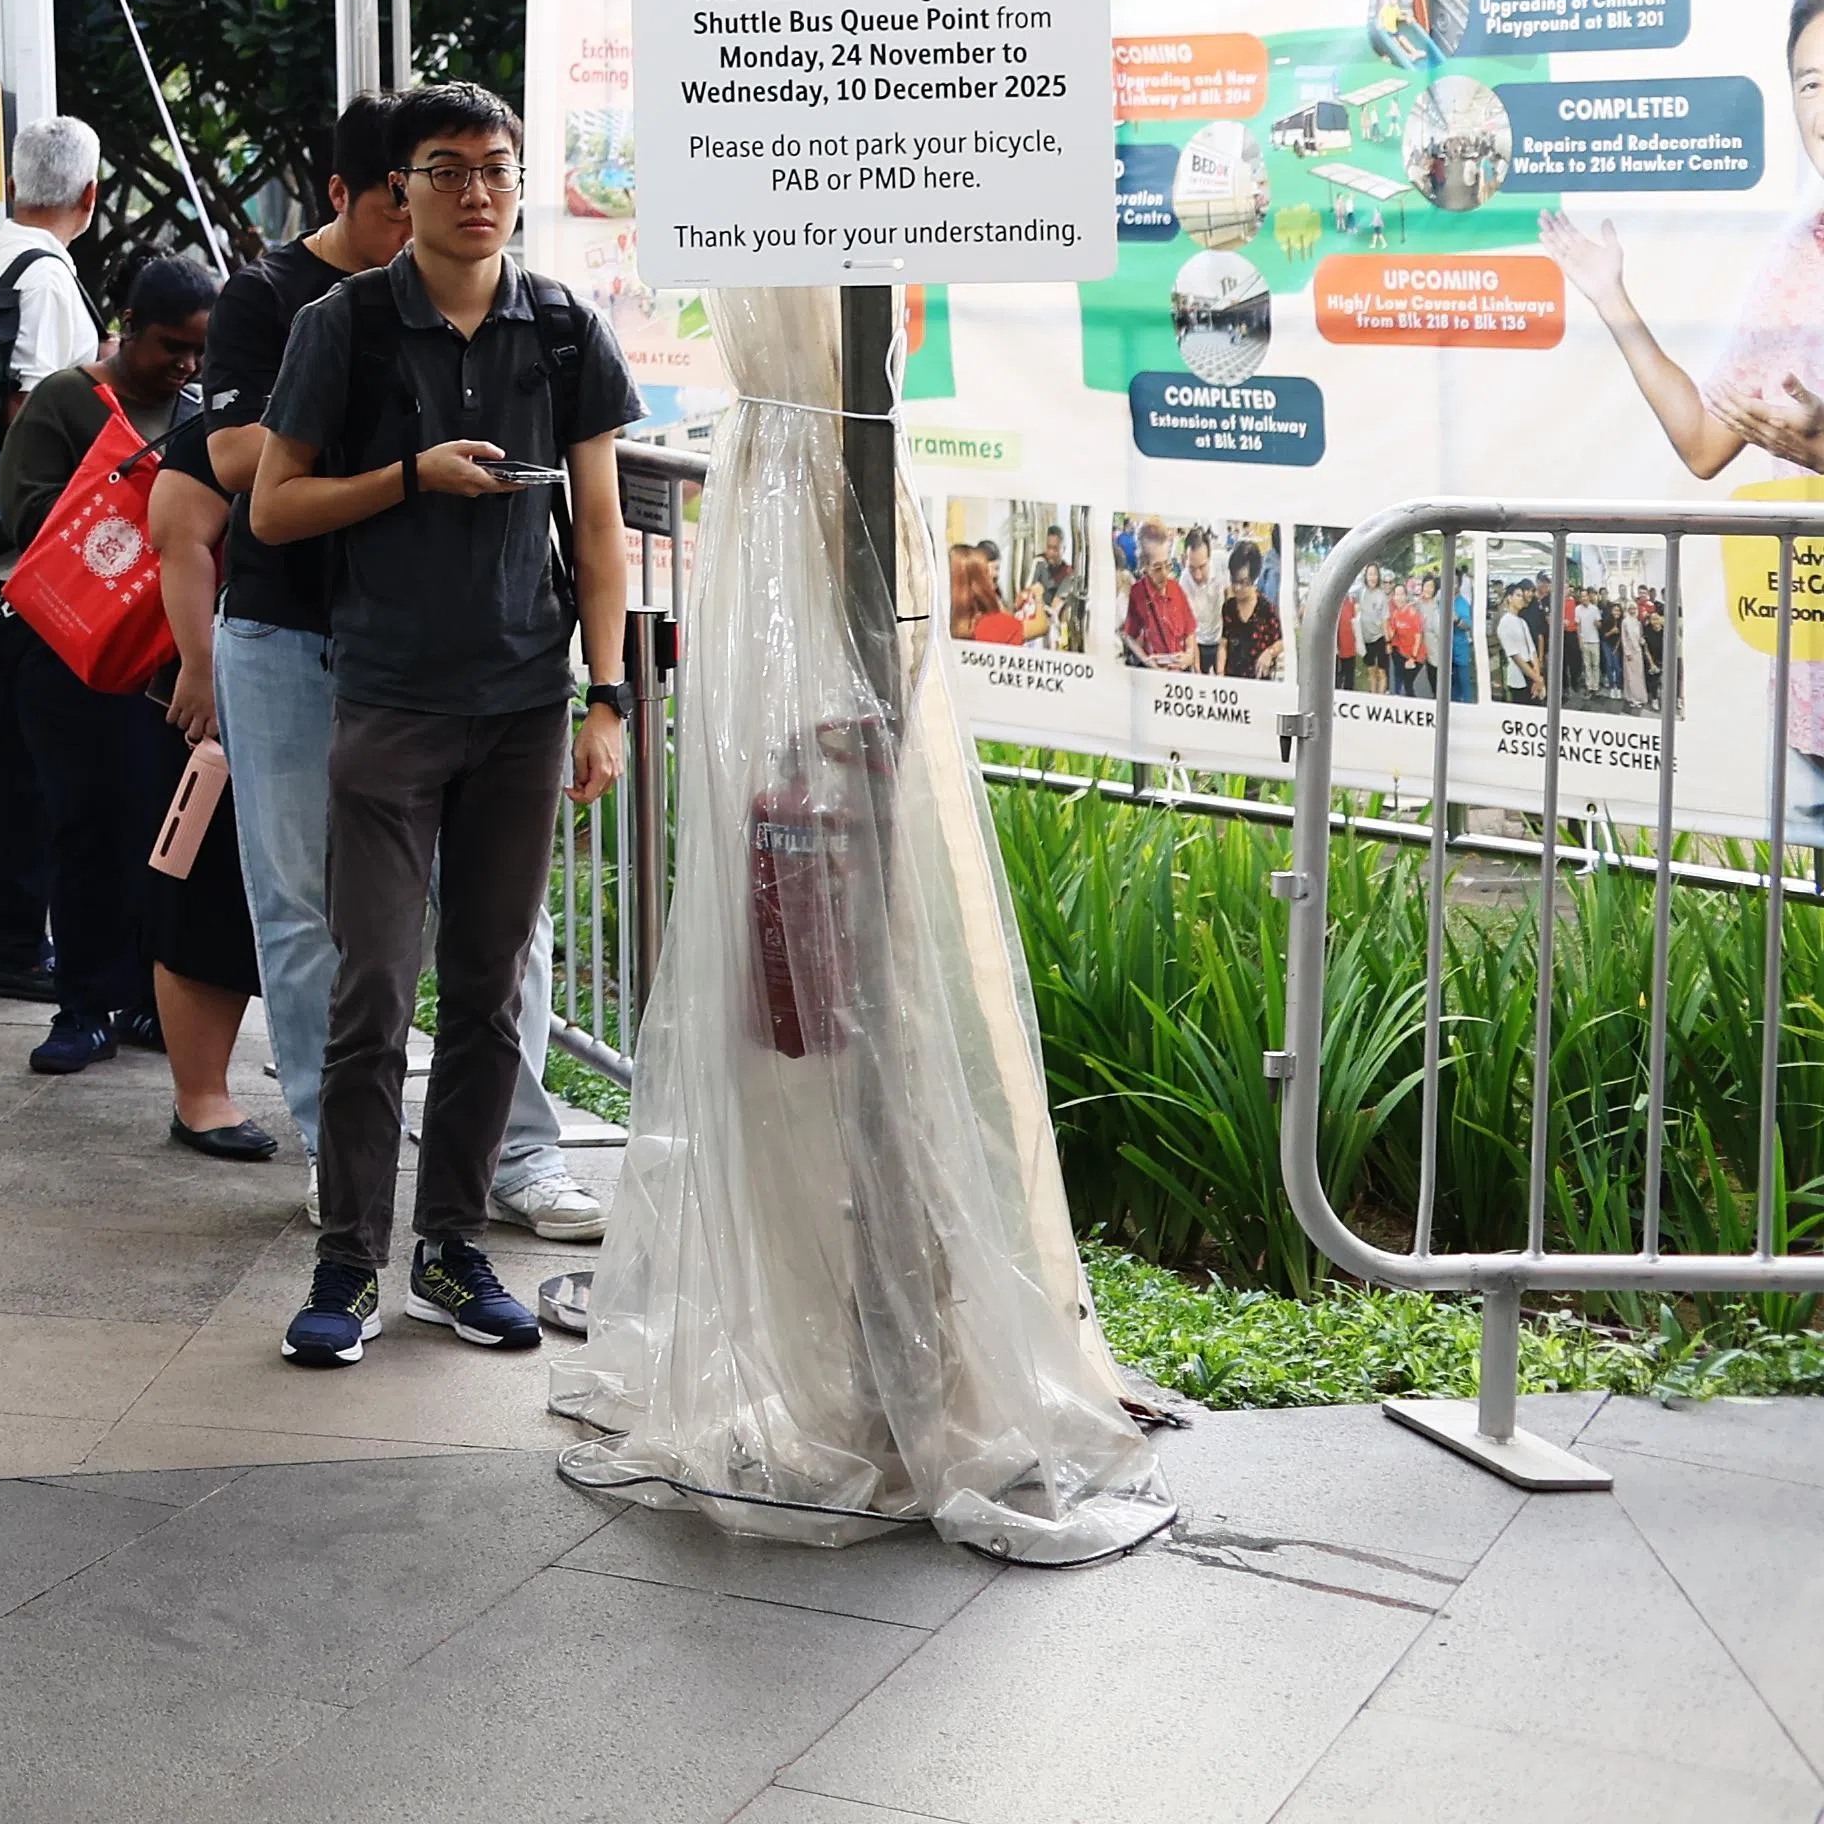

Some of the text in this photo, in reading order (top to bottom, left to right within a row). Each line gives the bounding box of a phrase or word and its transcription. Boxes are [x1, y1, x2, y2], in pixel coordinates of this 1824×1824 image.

[693, 5, 1051, 36] Shuttle Bus Queue Point from
[1486, 10, 1665, 38] Playground at Blk 201
[720, 41, 1027, 73] Monday, 24 November to
[681, 74, 1067, 108] Wednesday, 10 December 2025
[1558, 96, 1690, 121] COMPLETED
[690, 129, 1062, 162] Please do not park your bicycle,
[1523, 132, 1743, 158] Repairs and Redecoration
[1514, 153, 1749, 174] Works to 216 Hawker Centre
[772, 165, 981, 192] PAB or PMD here.
[673, 219, 1082, 253] Thank you for your understanding.
[1164, 386, 1277, 411] COMPLETED
[1149, 412, 1307, 438] Extension of Walkway
[1195, 433, 1263, 451] at Blk 216
[988, 670, 1065, 694] CARE PACK
[1164, 683, 1194, 701] 200
[1212, 688, 1239, 705] 100
[1153, 699, 1252, 726] PROGRAMME
